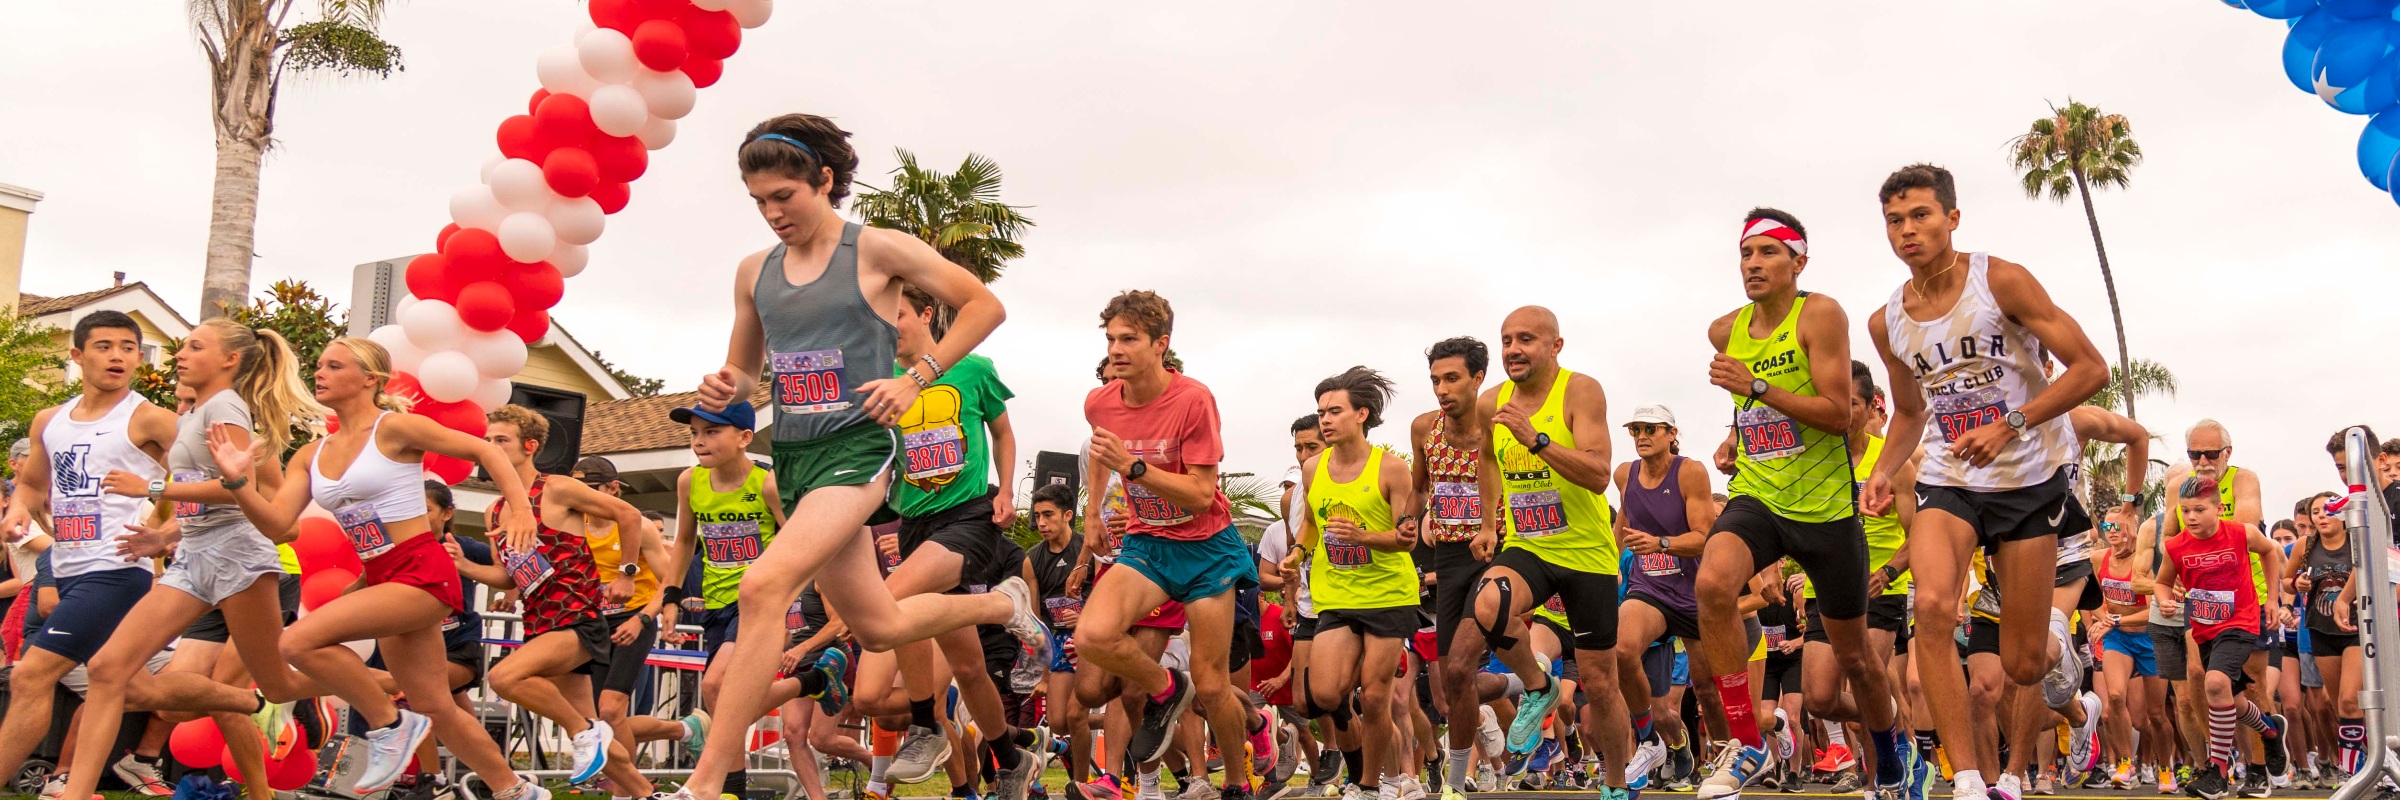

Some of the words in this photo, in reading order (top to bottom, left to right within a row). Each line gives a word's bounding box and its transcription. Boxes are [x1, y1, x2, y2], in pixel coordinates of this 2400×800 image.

[1753, 350, 1795, 373] COAST
[1914, 334, 2006, 379] ALOR
[1784, 366, 1799, 374] CLUB
[1963, 365, 2004, 389] CLUB
[779, 371, 840, 404] 3509
[1745, 421, 1795, 453] 3426
[906, 442, 958, 472] 3876
[1533, 480, 1553, 489] Club
[718, 511, 763, 522] COAST
[1135, 497, 1185, 519] 3531
[1439, 496, 1481, 518] 3875
[1513, 505, 1561, 532] 3414
[707, 536, 759, 561] 3750
[1327, 545, 1368, 564] 3779
[1641, 552, 1676, 571] 3281
[2191, 600, 2231, 620] 3678
